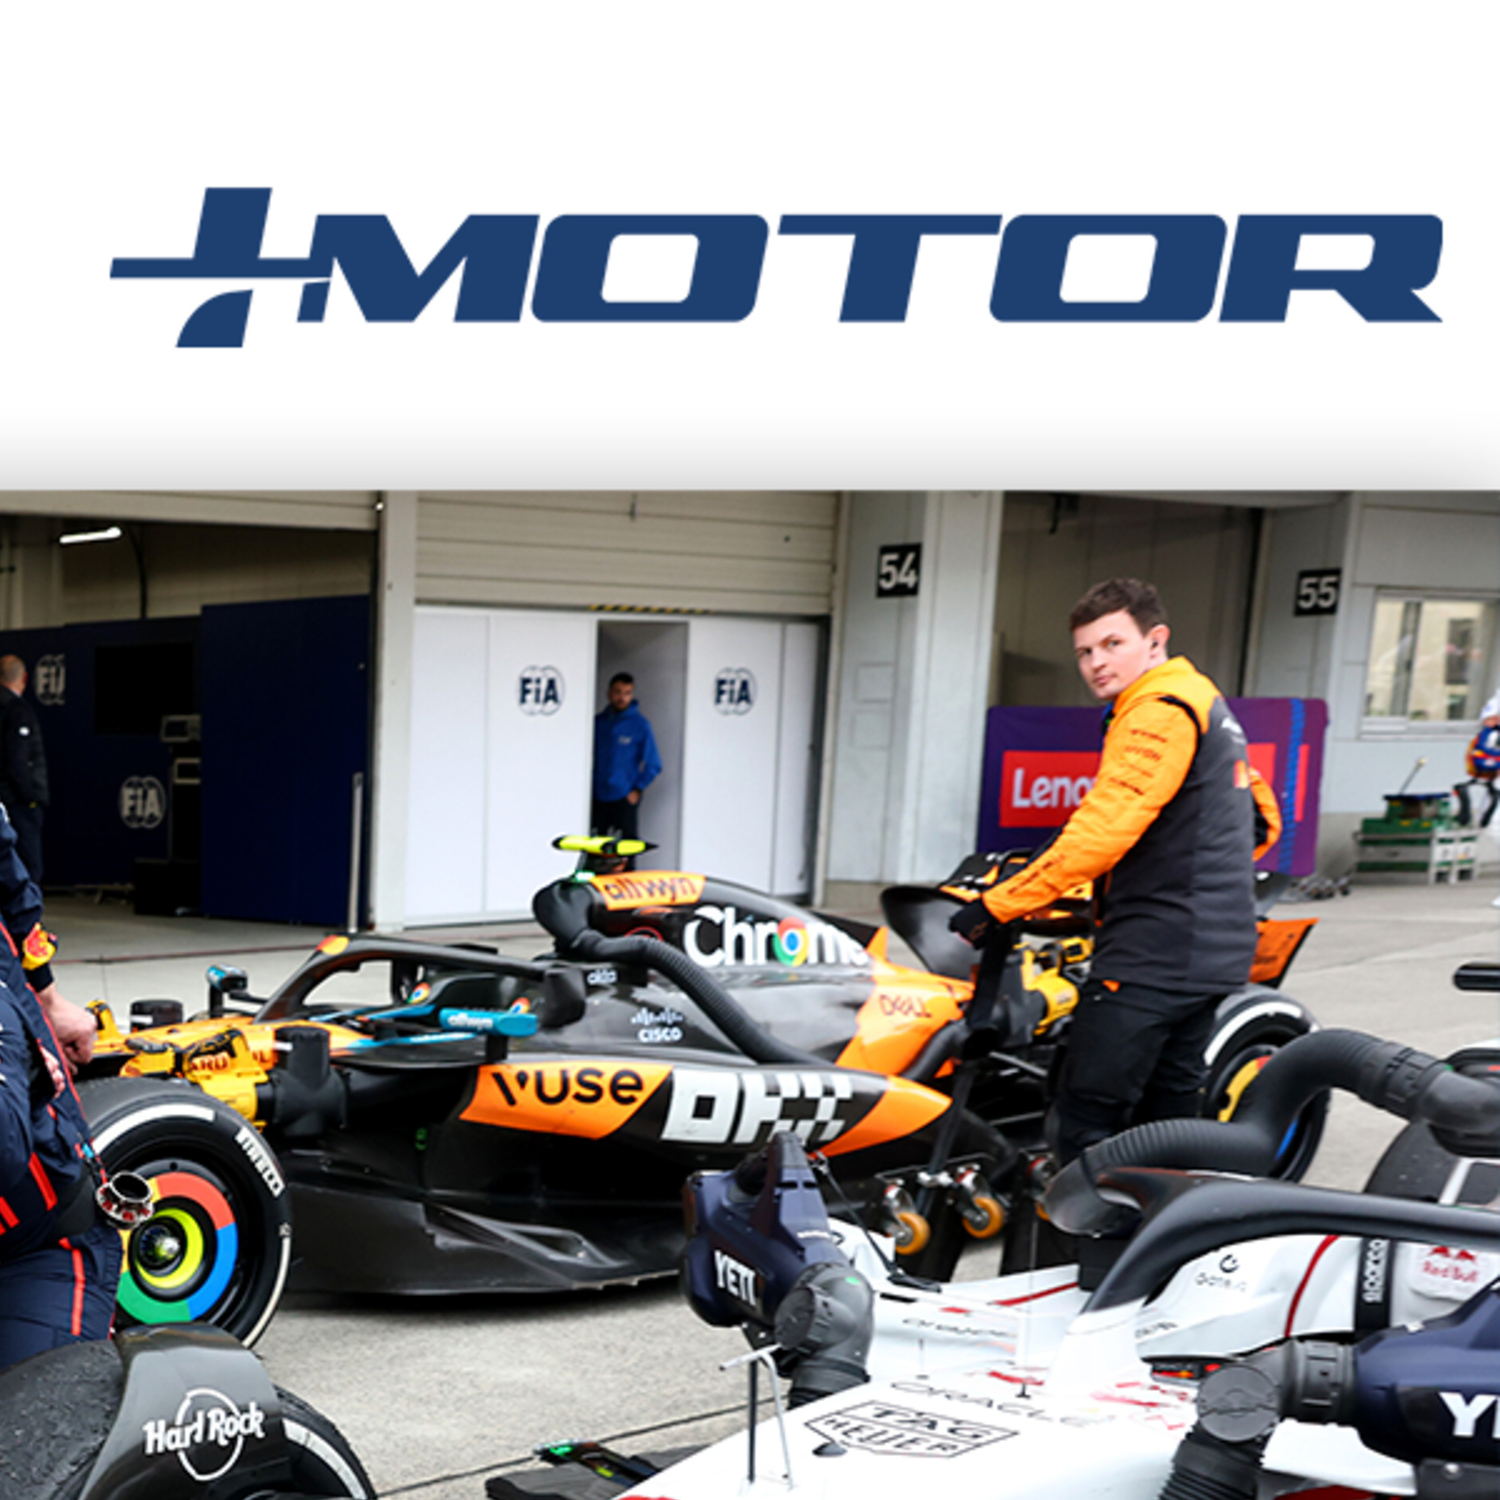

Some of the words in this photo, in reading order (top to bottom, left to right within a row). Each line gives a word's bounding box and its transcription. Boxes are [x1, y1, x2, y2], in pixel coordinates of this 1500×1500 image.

[880, 553, 918, 590] 54
[1299, 576, 1338, 609] 55
[1012, 768, 1098, 808] Leno
[604, 876, 698, 903] allwyn
[683, 905, 869, 967] Chrome
[879, 993, 933, 1018] DELL
[637, 1027, 683, 1042] CISCO
[660, 1069, 853, 1144] OKX
[235, 1125, 285, 1198] PIRELLI
[714, 1250, 757, 1307] YETI
[142, 1409, 206, 1455] Hard
[207, 1401, 266, 1447] Rock
[871, 1406, 994, 1440] TAG
